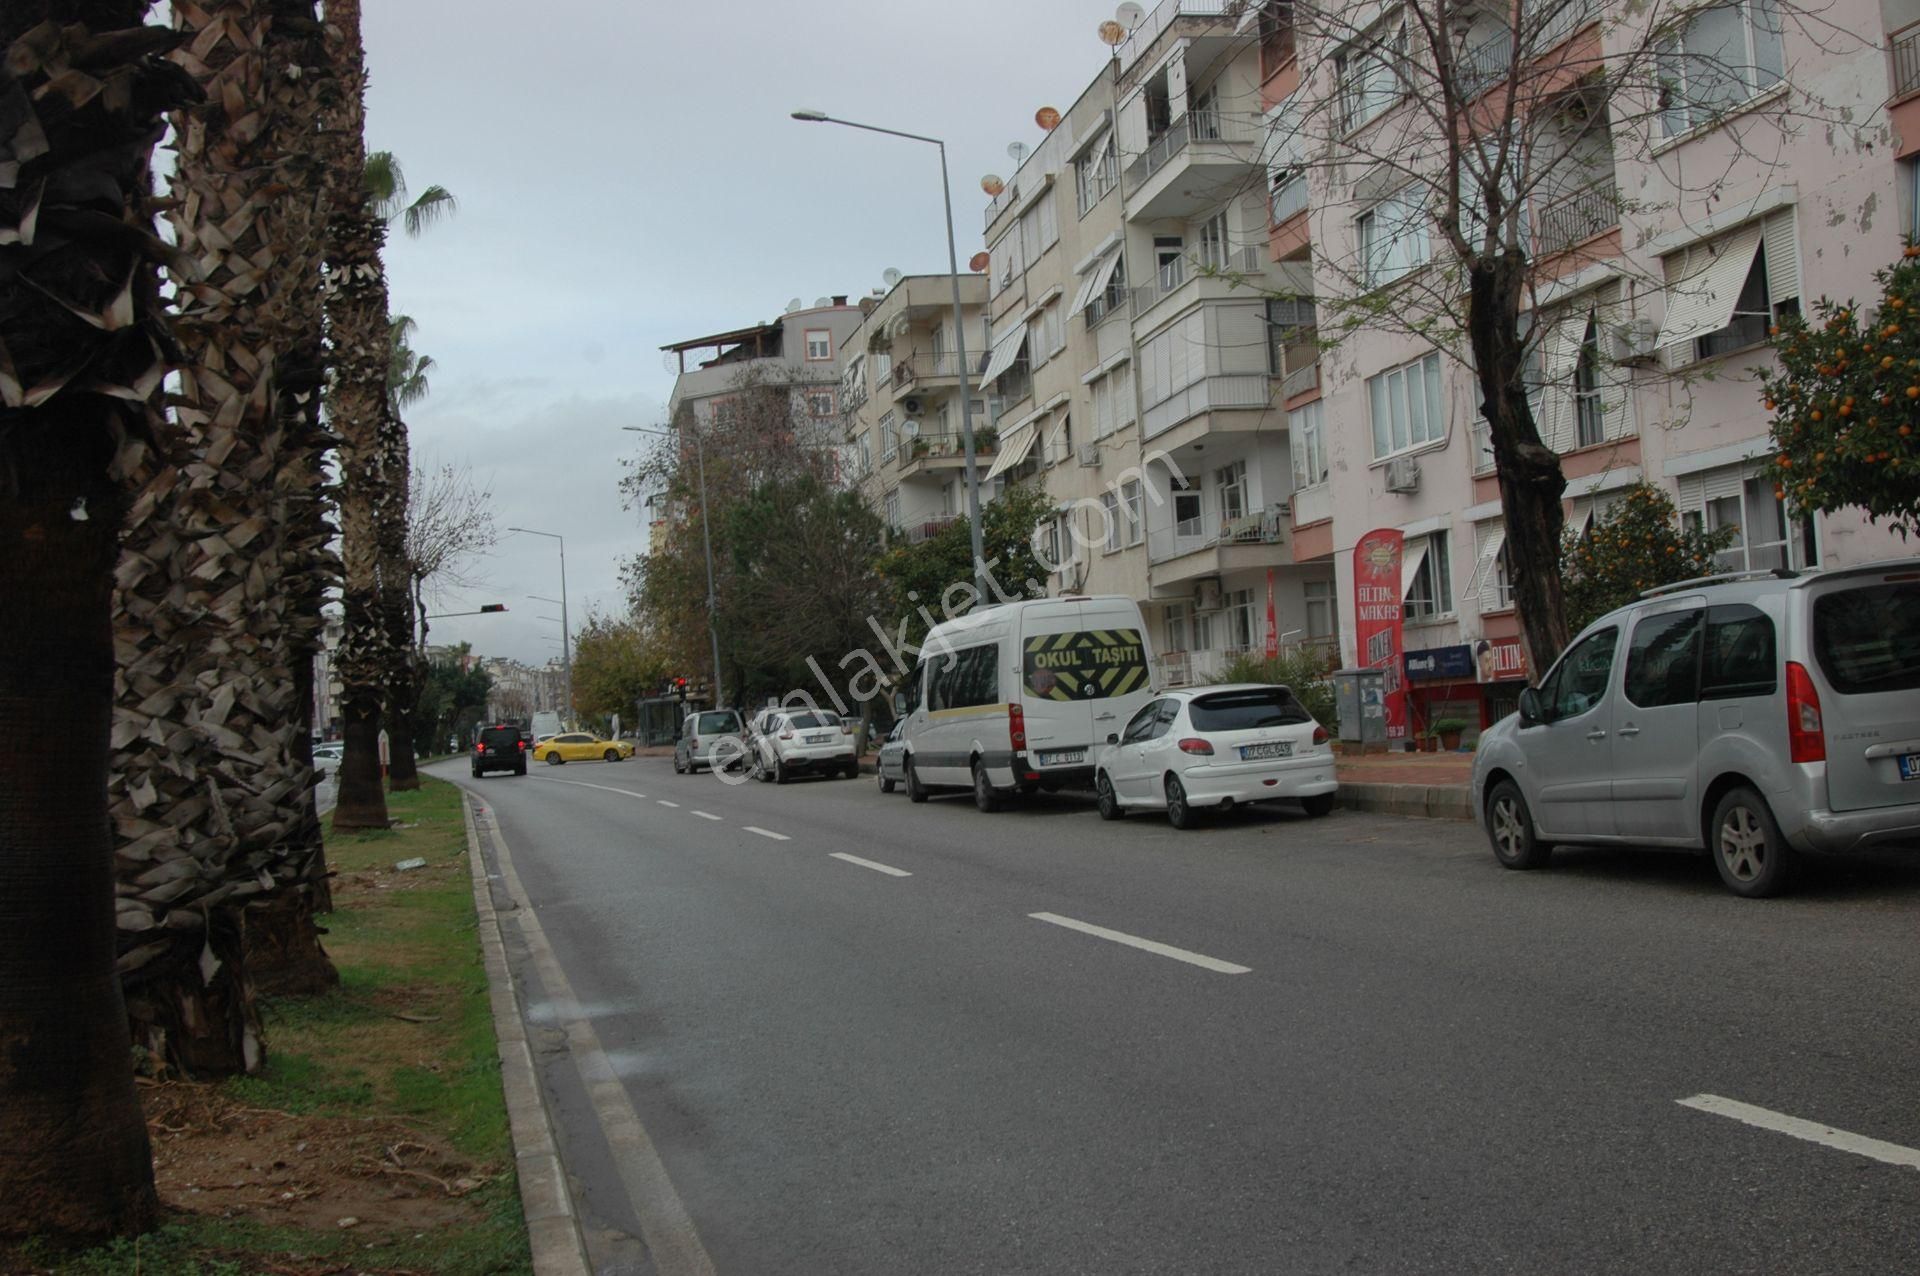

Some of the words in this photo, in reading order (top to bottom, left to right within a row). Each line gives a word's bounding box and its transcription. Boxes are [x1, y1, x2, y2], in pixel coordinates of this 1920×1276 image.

[1359, 587, 1393, 602] ALTIN
[1360, 604, 1399, 620] MAKAS
[1034, 650, 1082, 668] OKUL
[1092, 646, 1139, 666] TAŞITI
[1492, 644, 1521, 671] ALTIN
